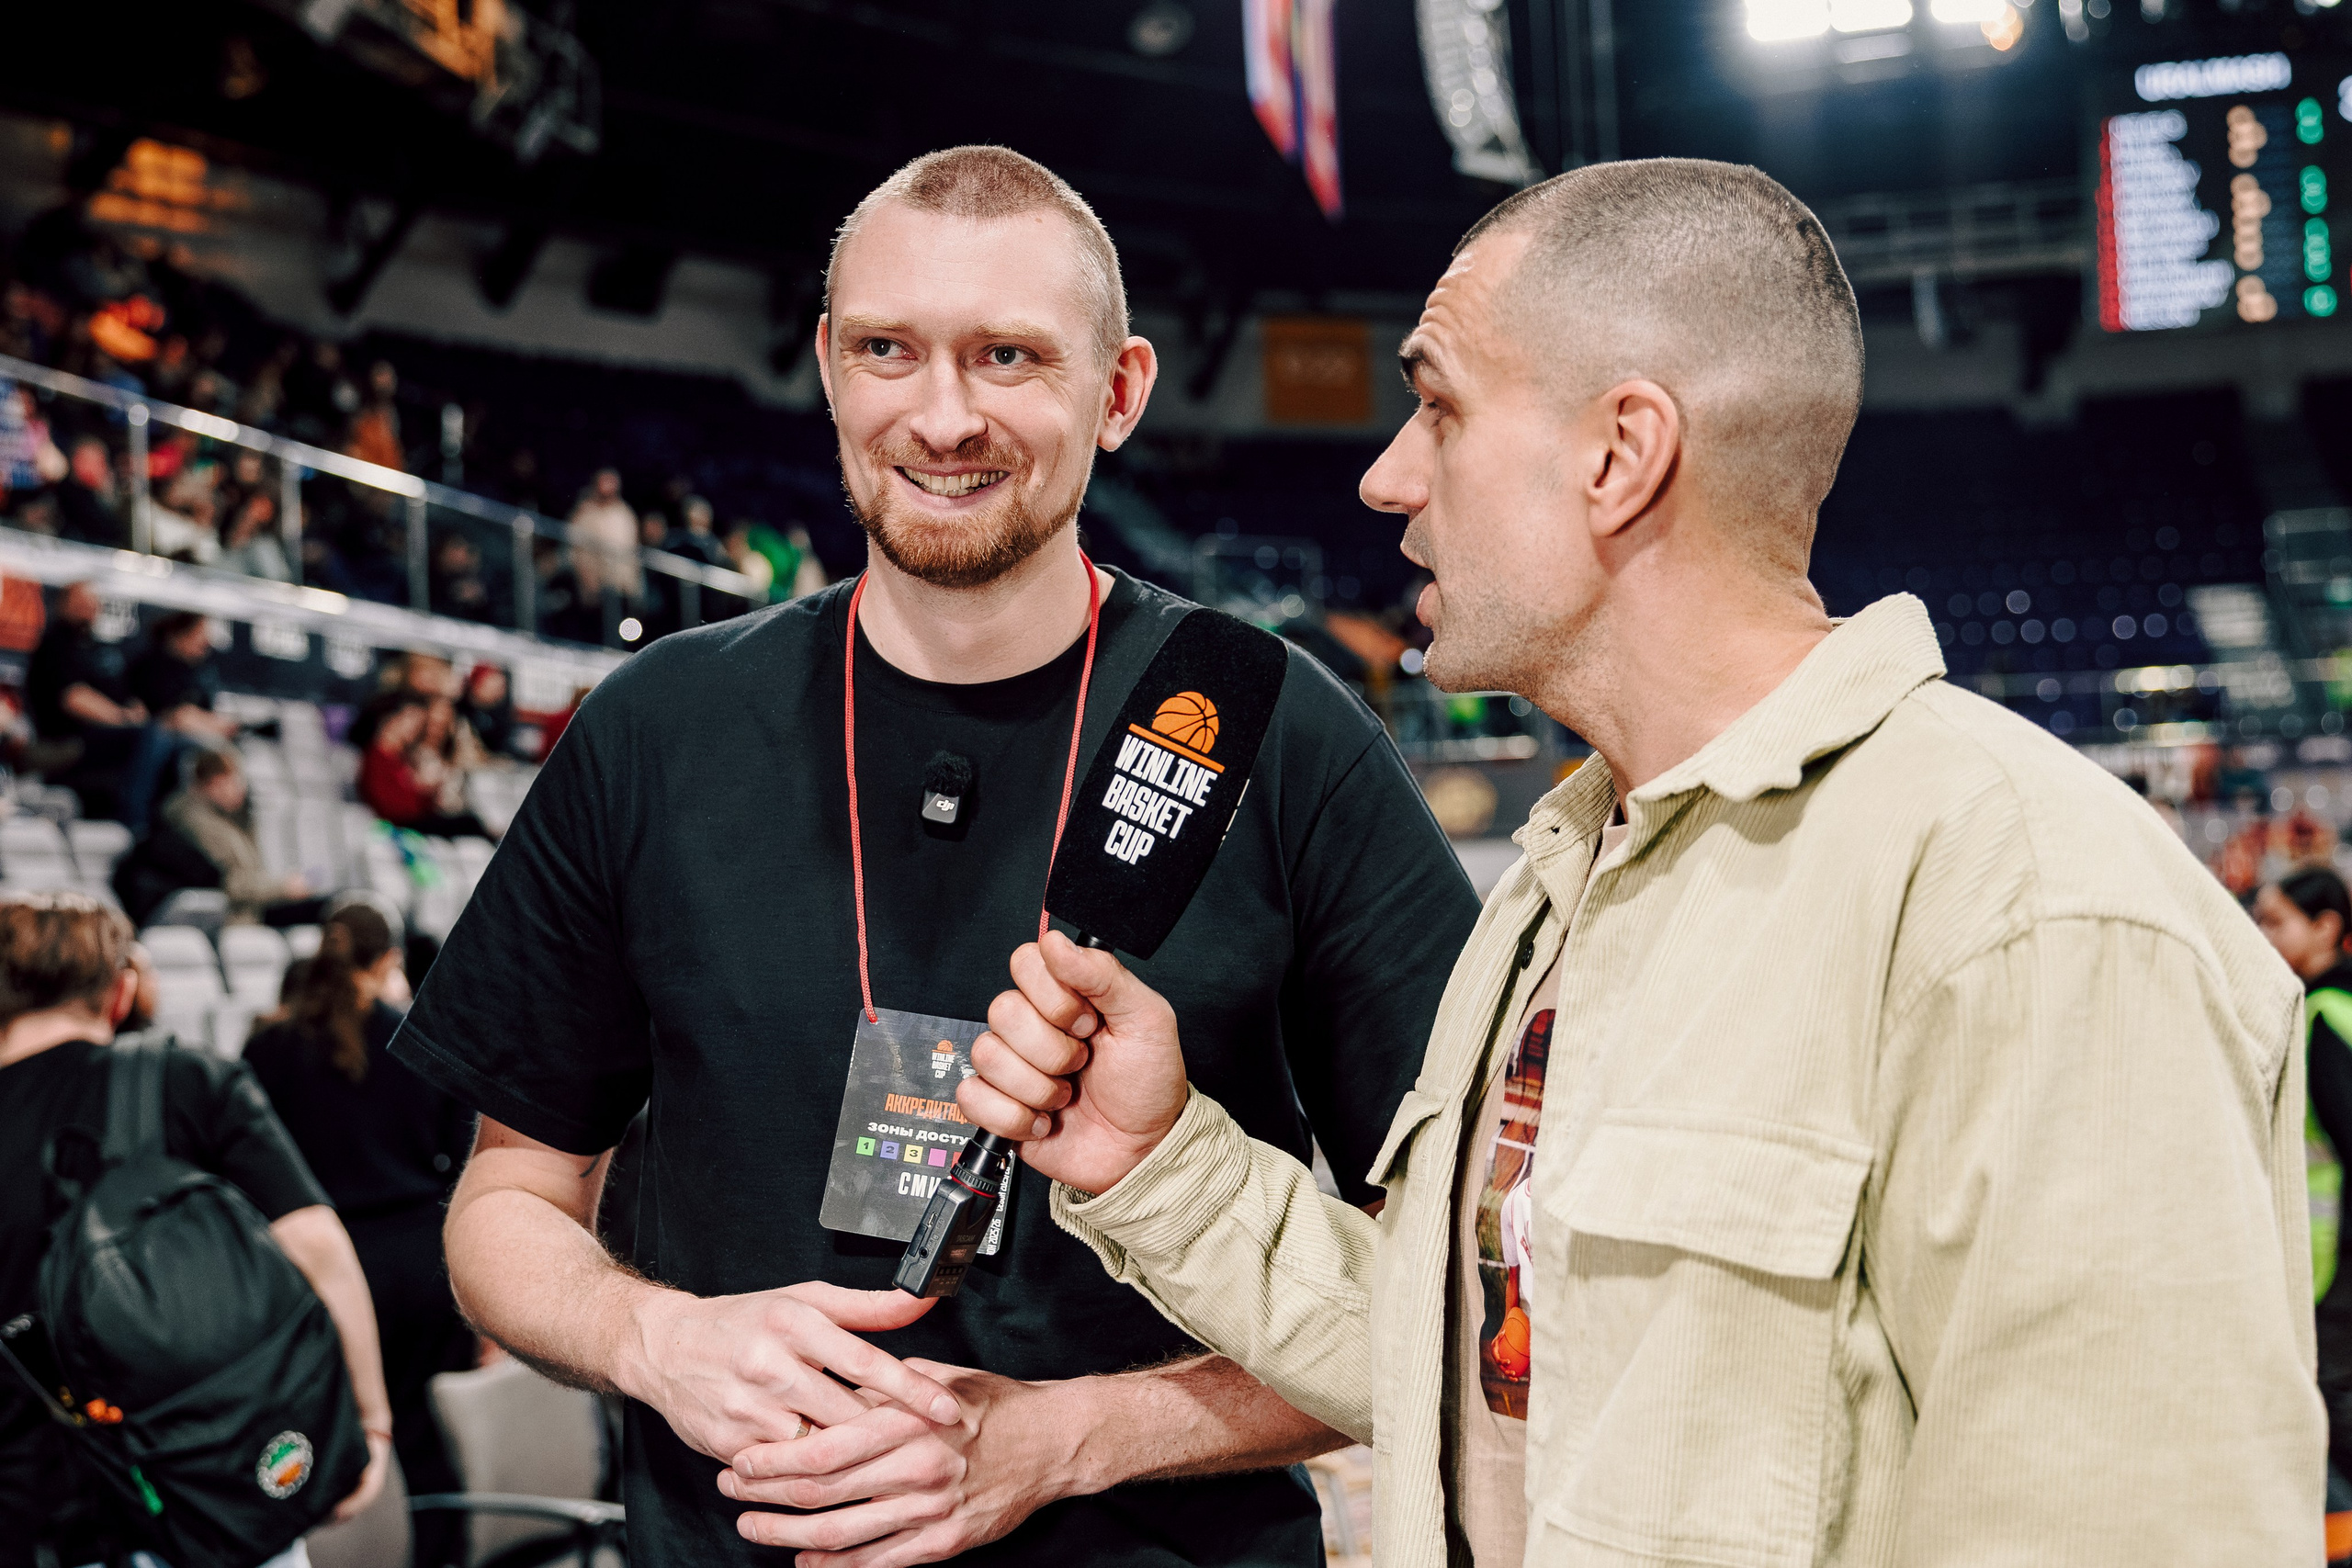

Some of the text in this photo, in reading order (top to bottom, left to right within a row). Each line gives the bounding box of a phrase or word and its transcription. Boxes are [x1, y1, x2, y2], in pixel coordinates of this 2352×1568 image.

[1114, 734, 1217, 807] WINLINE
[1102, 773, 1193, 840] BASKET
[1104, 819, 1155, 865] CUP
[932, 1052, 956, 1064] WINLINE
[932, 1060, 952, 1071] BASKET
[934, 1069, 946, 1079] CUP
[884, 1093, 971, 1125] АККРЕДИТАЦ
[915, 1129, 971, 1145] ДОСТУ
[863, 1142, 870, 1150] 1
[886, 1145, 895, 1154] 2
[909, 1149, 919, 1157] 3
[898, 1171, 942, 1199] СМИ
[989, 1218, 1001, 1245] 2025/26
